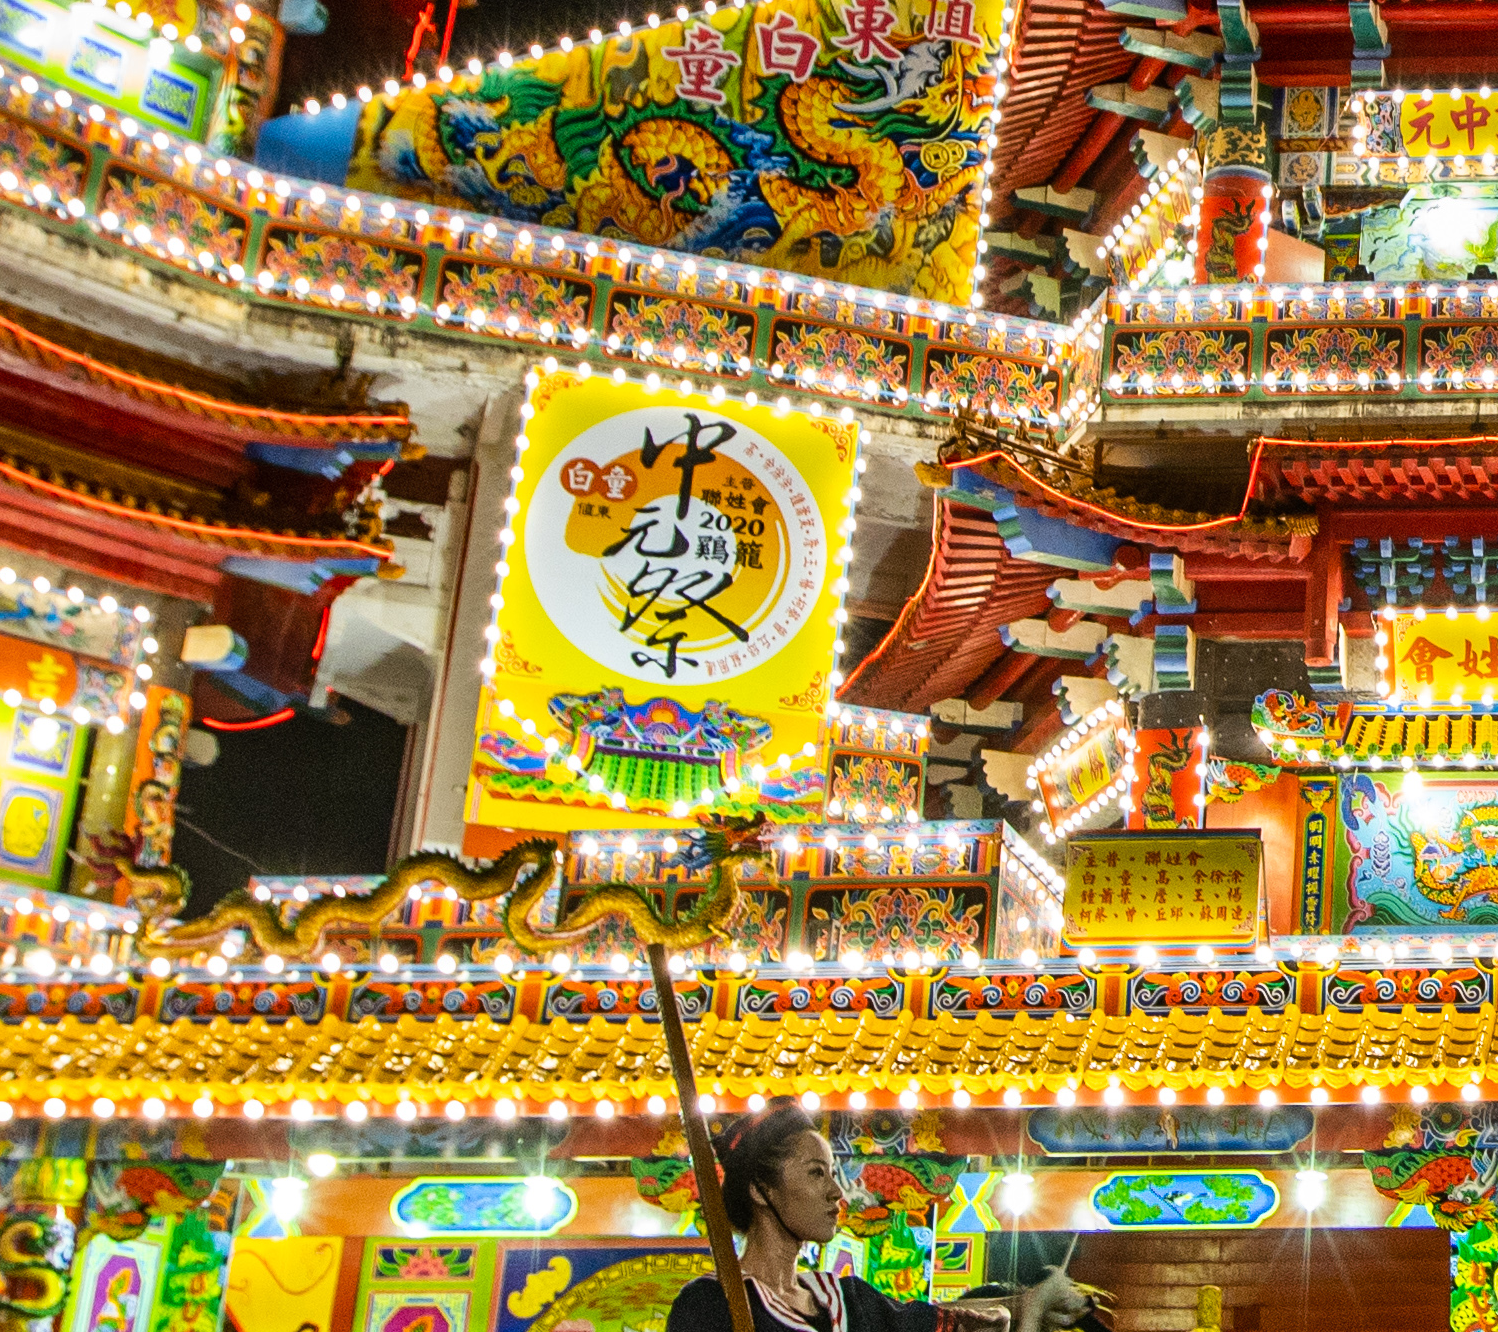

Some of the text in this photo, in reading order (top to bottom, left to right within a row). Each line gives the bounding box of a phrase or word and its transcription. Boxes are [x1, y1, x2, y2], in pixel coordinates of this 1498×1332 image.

[566, 462, 634, 500] 白童
[722, 475, 756, 491] 主普
[700, 488, 771, 516] 聯姓會
[699, 511, 765, 537] 2020
[602, 413, 750, 679] 中元祭
